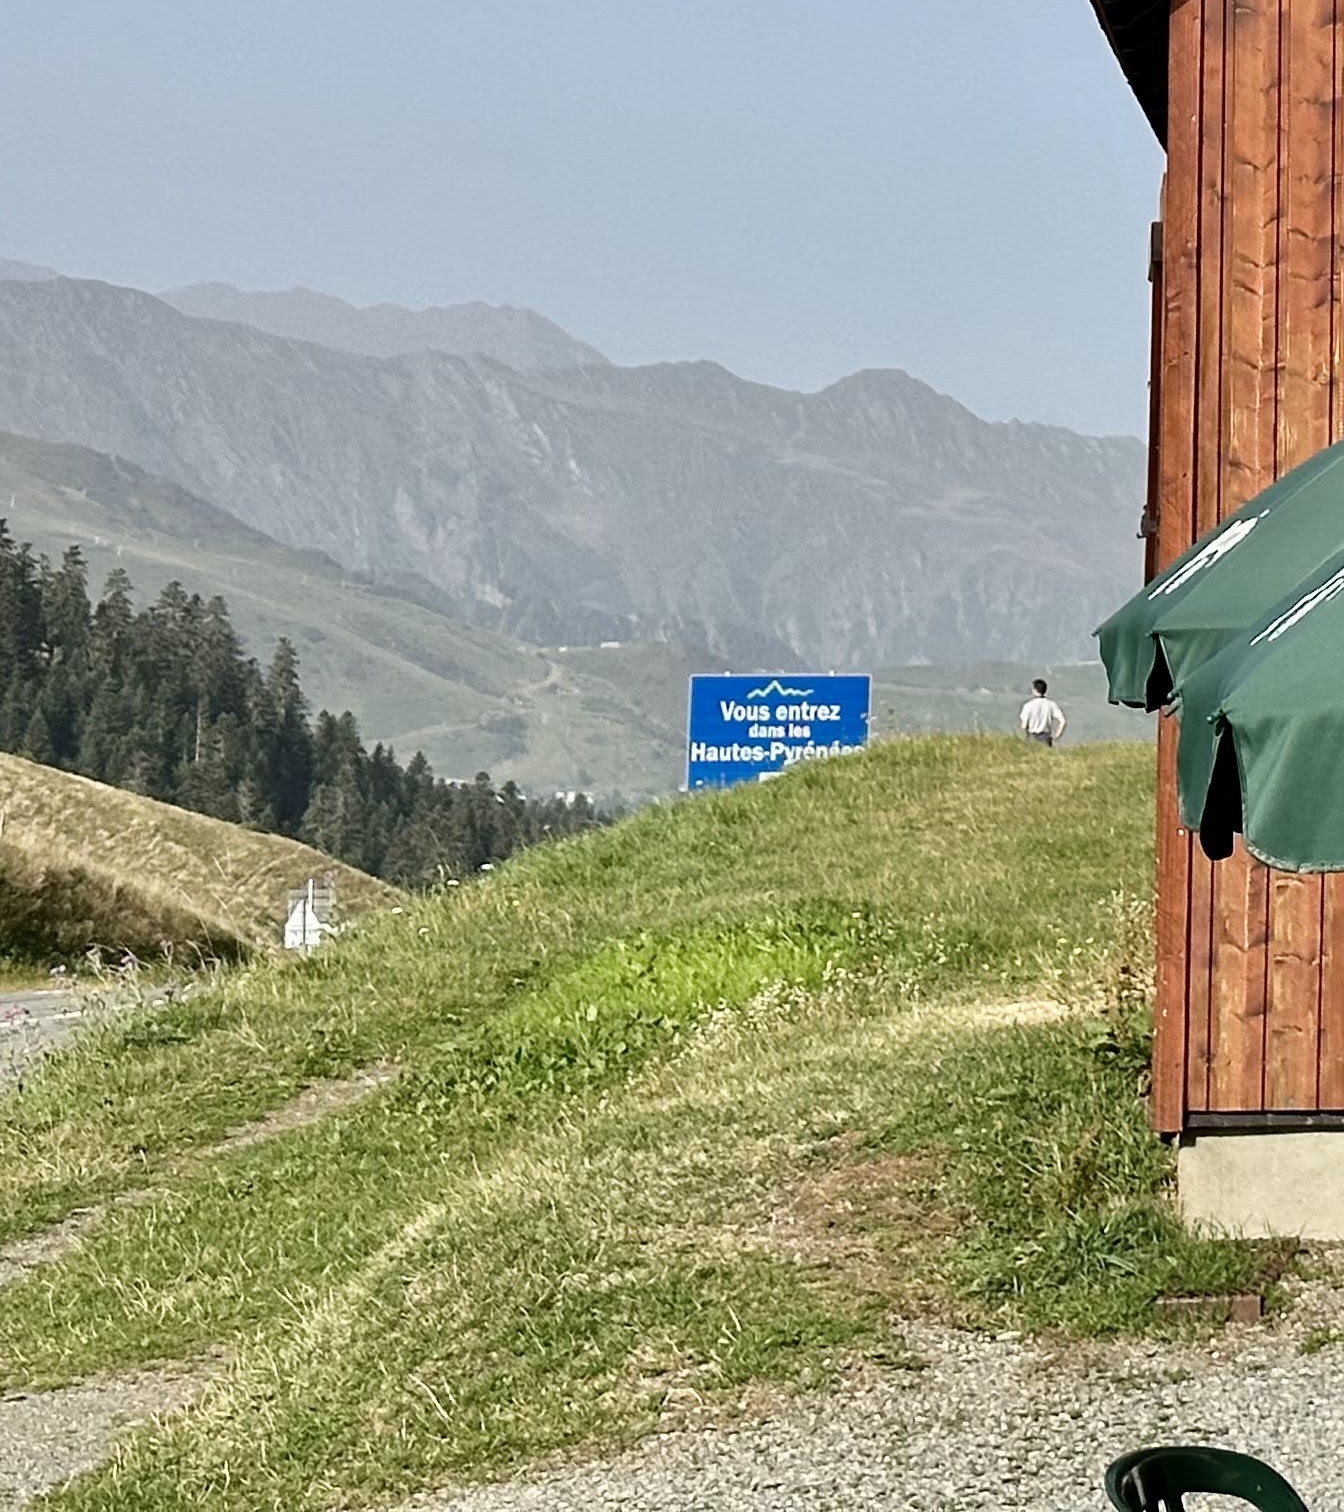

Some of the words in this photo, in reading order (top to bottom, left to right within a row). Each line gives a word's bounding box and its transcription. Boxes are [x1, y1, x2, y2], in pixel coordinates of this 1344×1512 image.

[720, 700, 771, 722] Vous
[775, 702, 841, 721] entrez
[748, 722, 786, 738] dans
[788, 722, 811, 738] les
